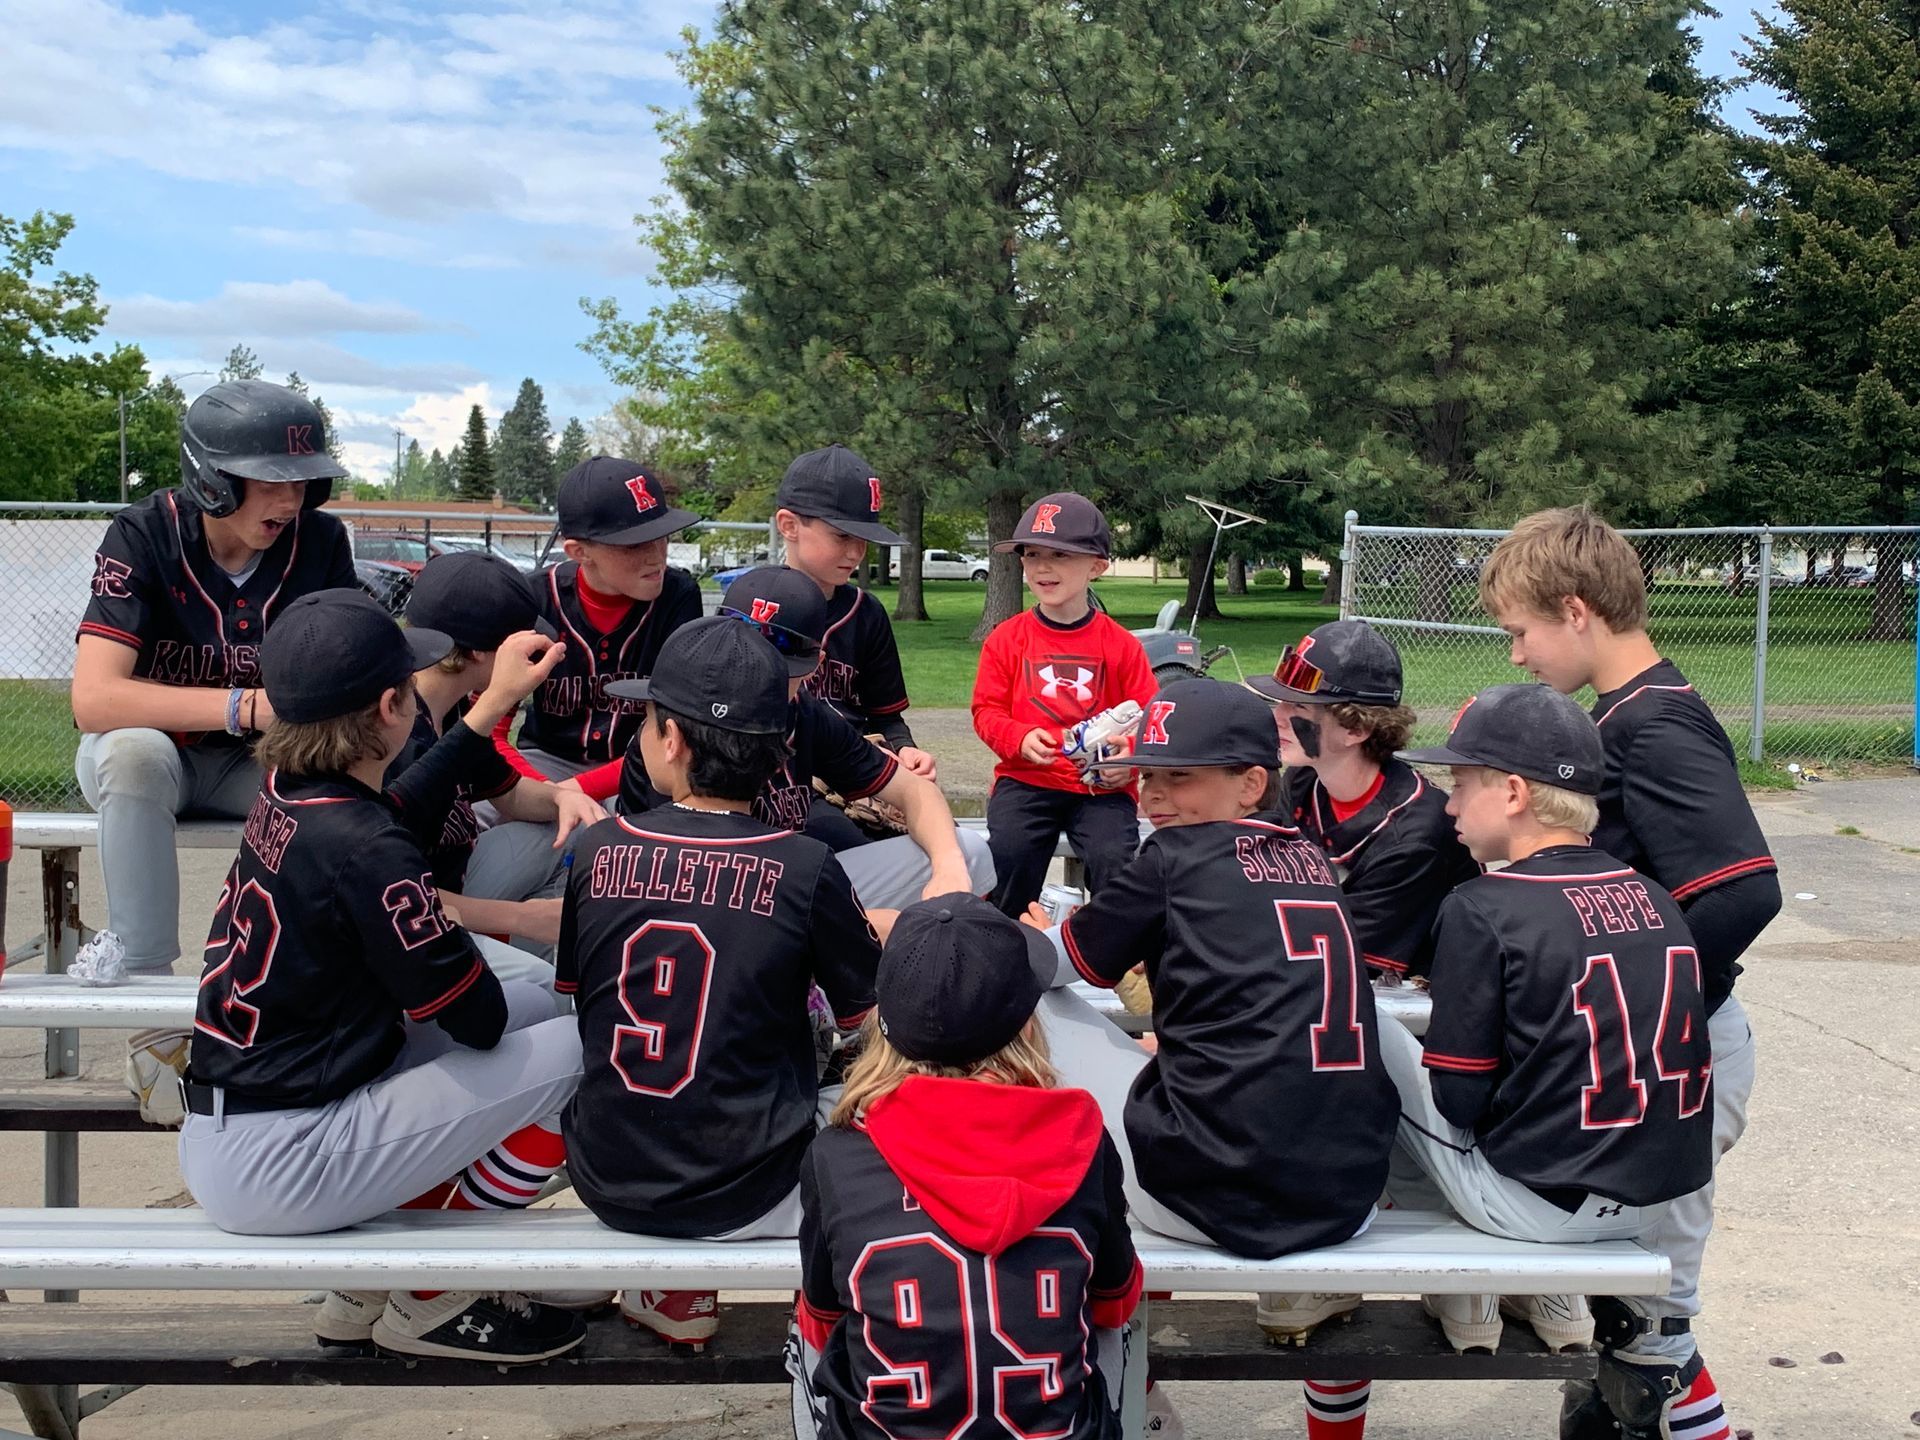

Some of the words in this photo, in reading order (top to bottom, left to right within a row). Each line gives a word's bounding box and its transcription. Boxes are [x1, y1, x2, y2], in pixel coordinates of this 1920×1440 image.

[288, 424, 315, 455] K
[624, 475, 658, 513] K
[1031, 503, 1062, 534] K
[1142, 700, 1177, 745] K
[590, 845, 785, 917] GILLETTE
[1562, 881, 1665, 937] PEPE
[609, 918, 717, 1099] 9
[1273, 899, 1366, 1073] 7
[1572, 946, 1713, 1131] 14
[848, 1226, 1094, 1440] 99
